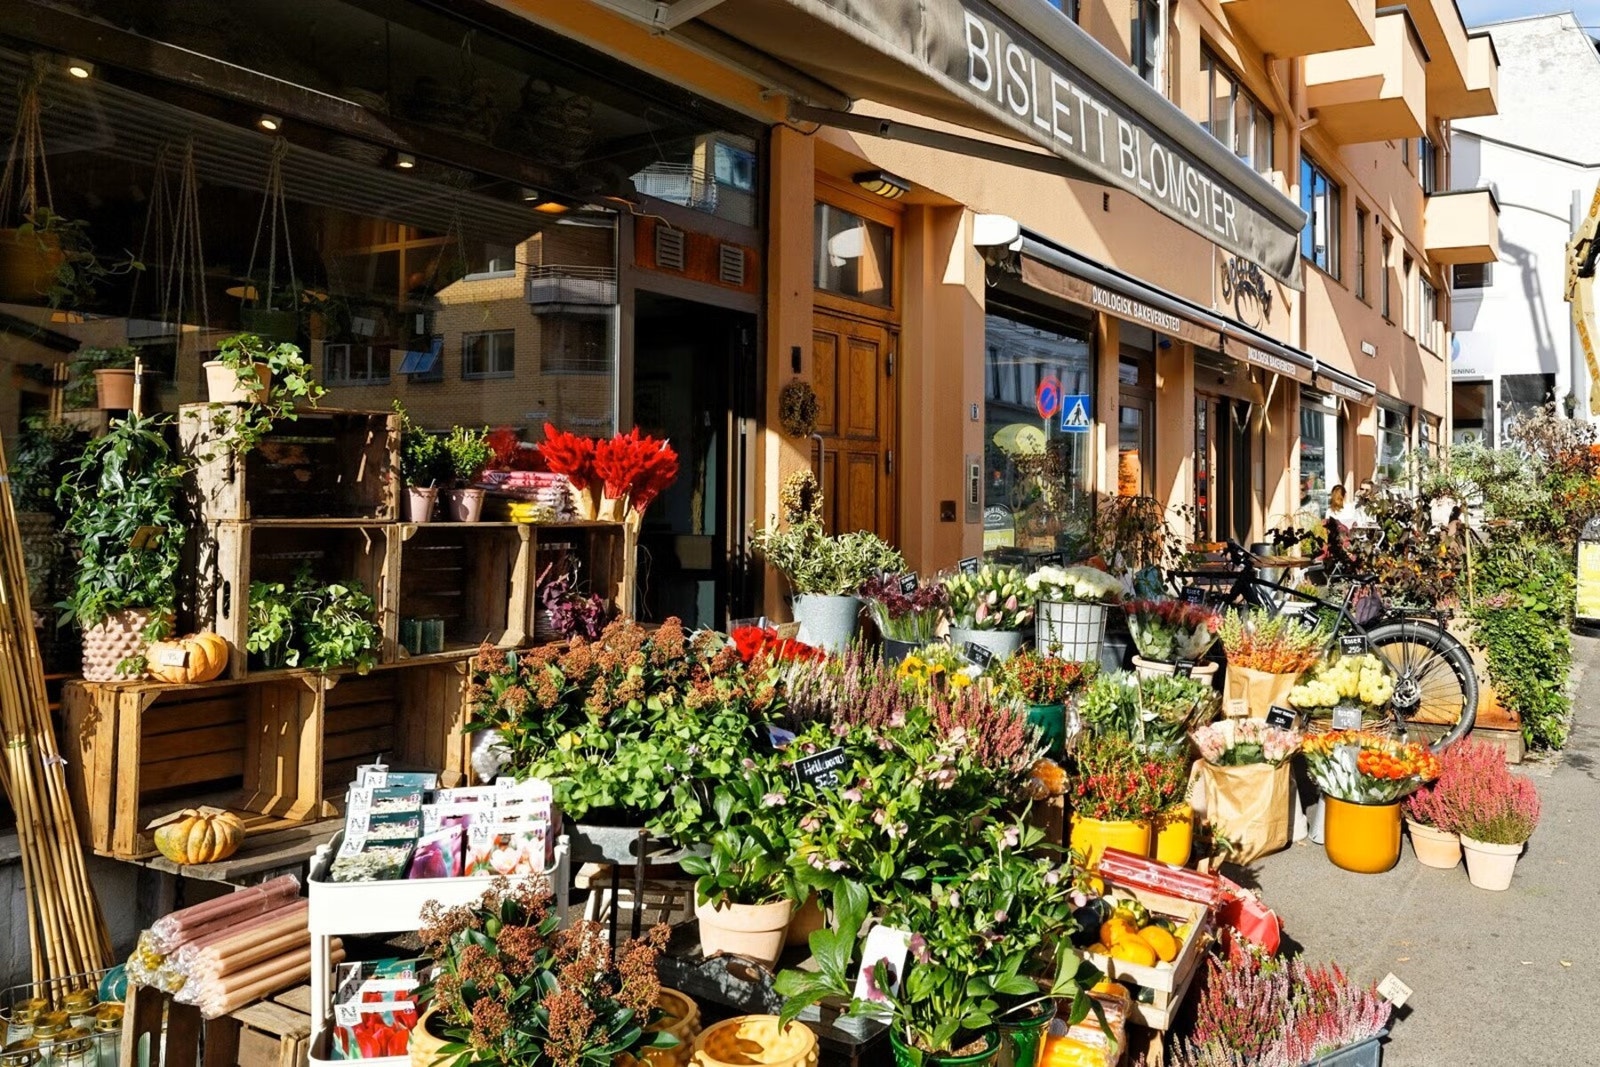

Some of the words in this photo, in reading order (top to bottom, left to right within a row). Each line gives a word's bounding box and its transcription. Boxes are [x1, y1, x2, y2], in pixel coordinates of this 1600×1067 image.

[964, 11, 1109, 163] BISLETT
[1116, 115, 1239, 242] BLOMSTER
[1092, 285, 1132, 316] ØKOLOGISK
[1133, 303, 1180, 332] BAKEVERKSTED
